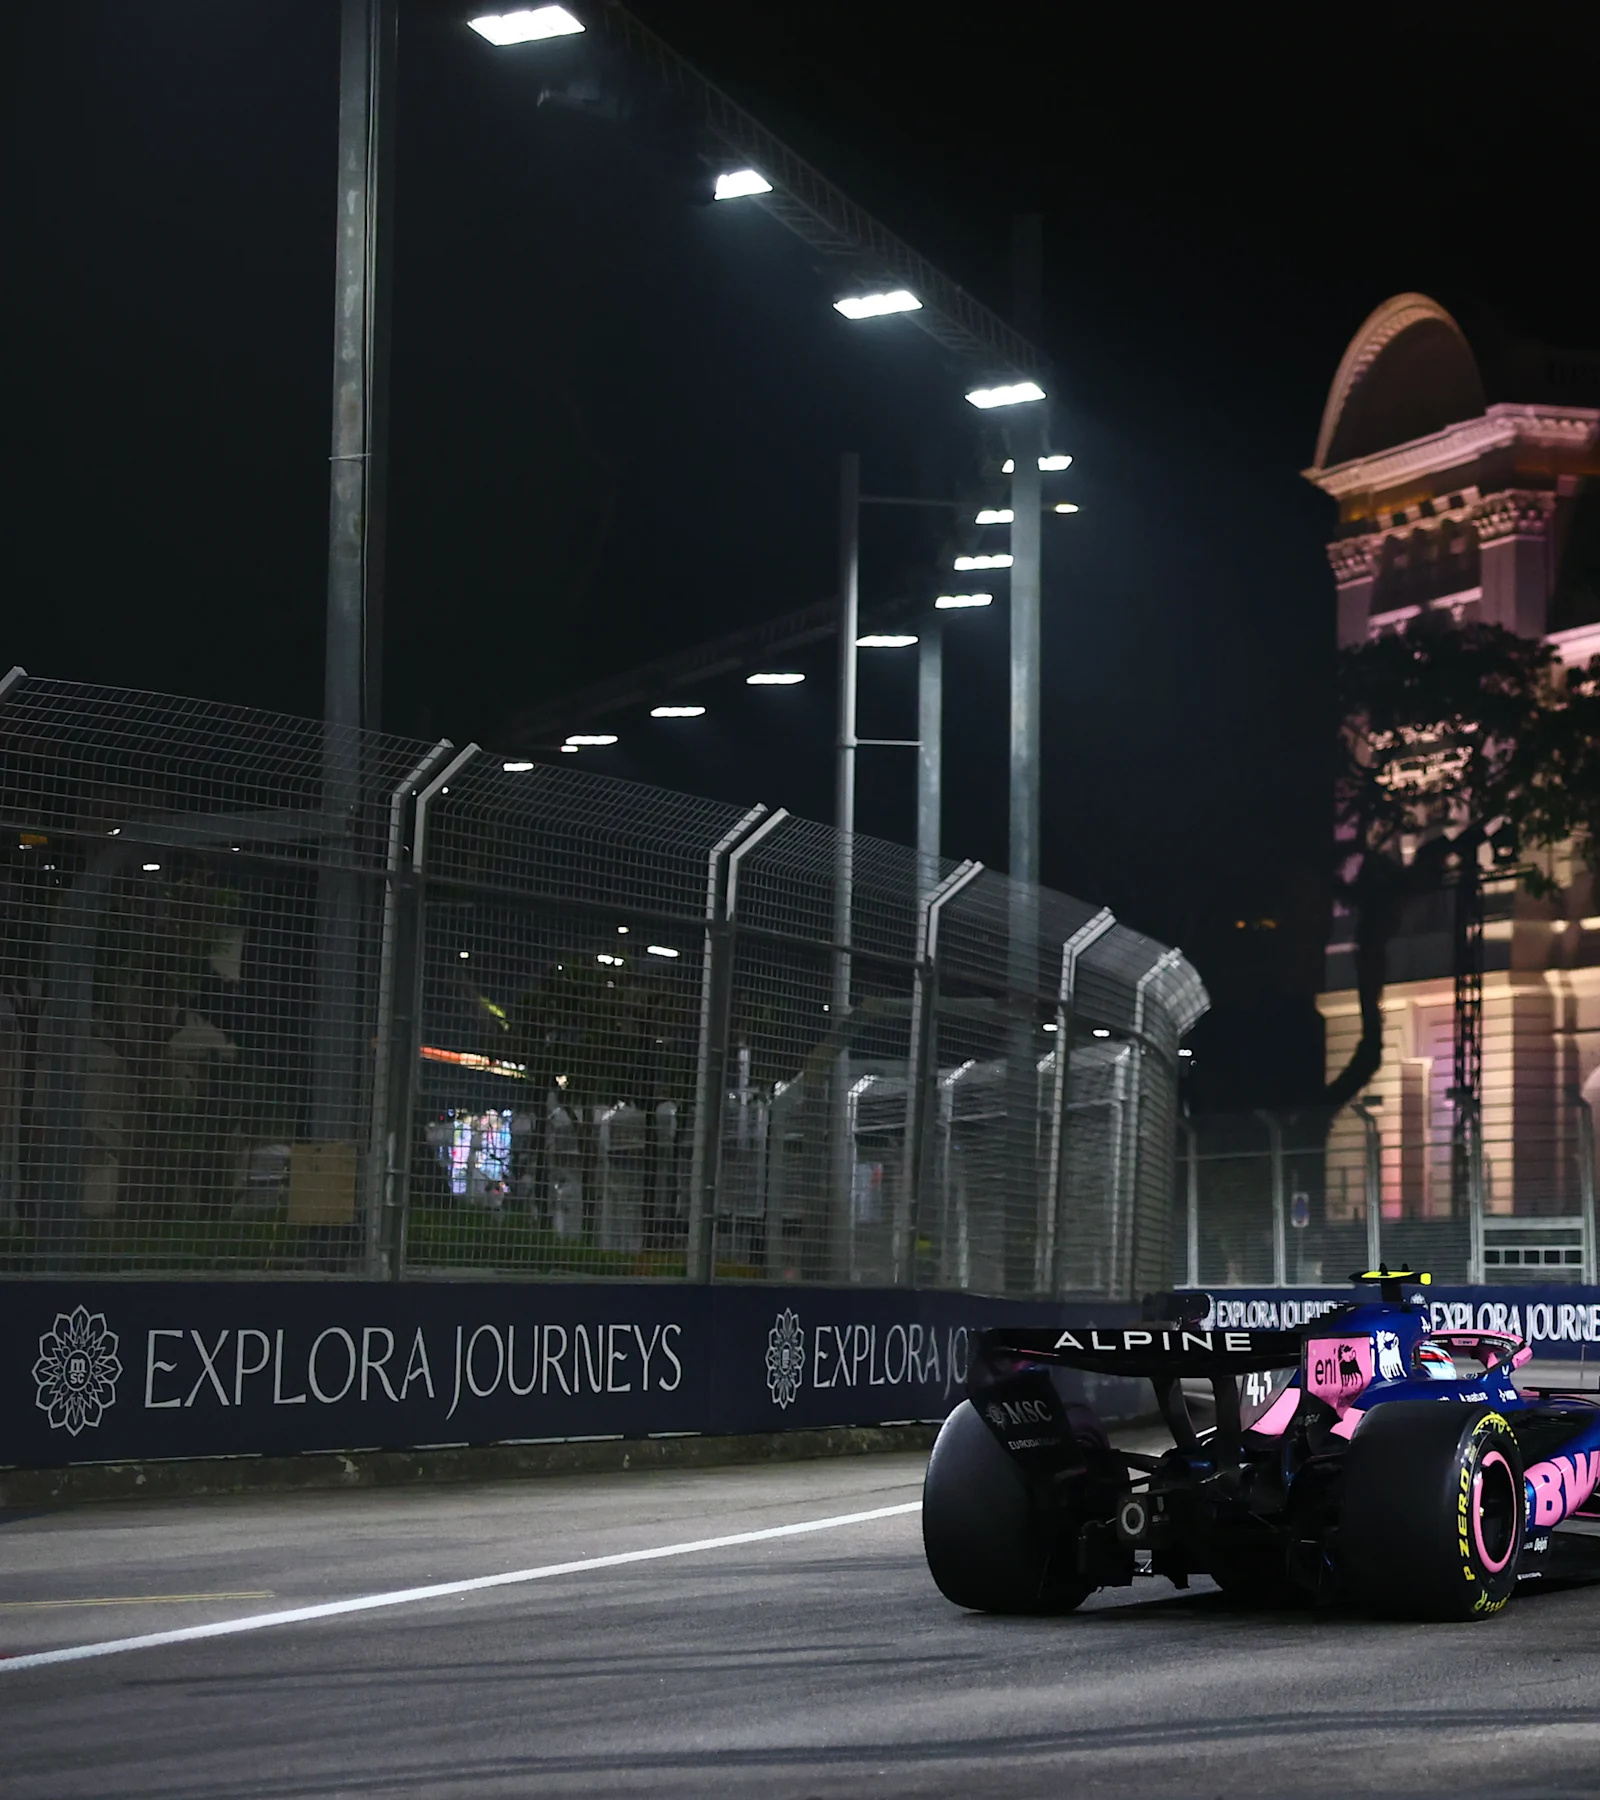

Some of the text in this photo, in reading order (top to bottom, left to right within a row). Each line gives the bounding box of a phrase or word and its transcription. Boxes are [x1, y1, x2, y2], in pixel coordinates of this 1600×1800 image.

[1217, 1300, 1280, 1330] EXPLORA
[1430, 1302, 1523, 1337] EXPLORA
[813, 1323, 942, 1389] EXPLORA
[1053, 1330, 1252, 1351] ALPINE
[145, 1324, 683, 1420] EXPLORA JOURNEYS
[1315, 1348, 1337, 1386] eni
[1002, 1400, 1053, 1425] MSC
[1457, 1467, 1476, 1582] P ZERO
